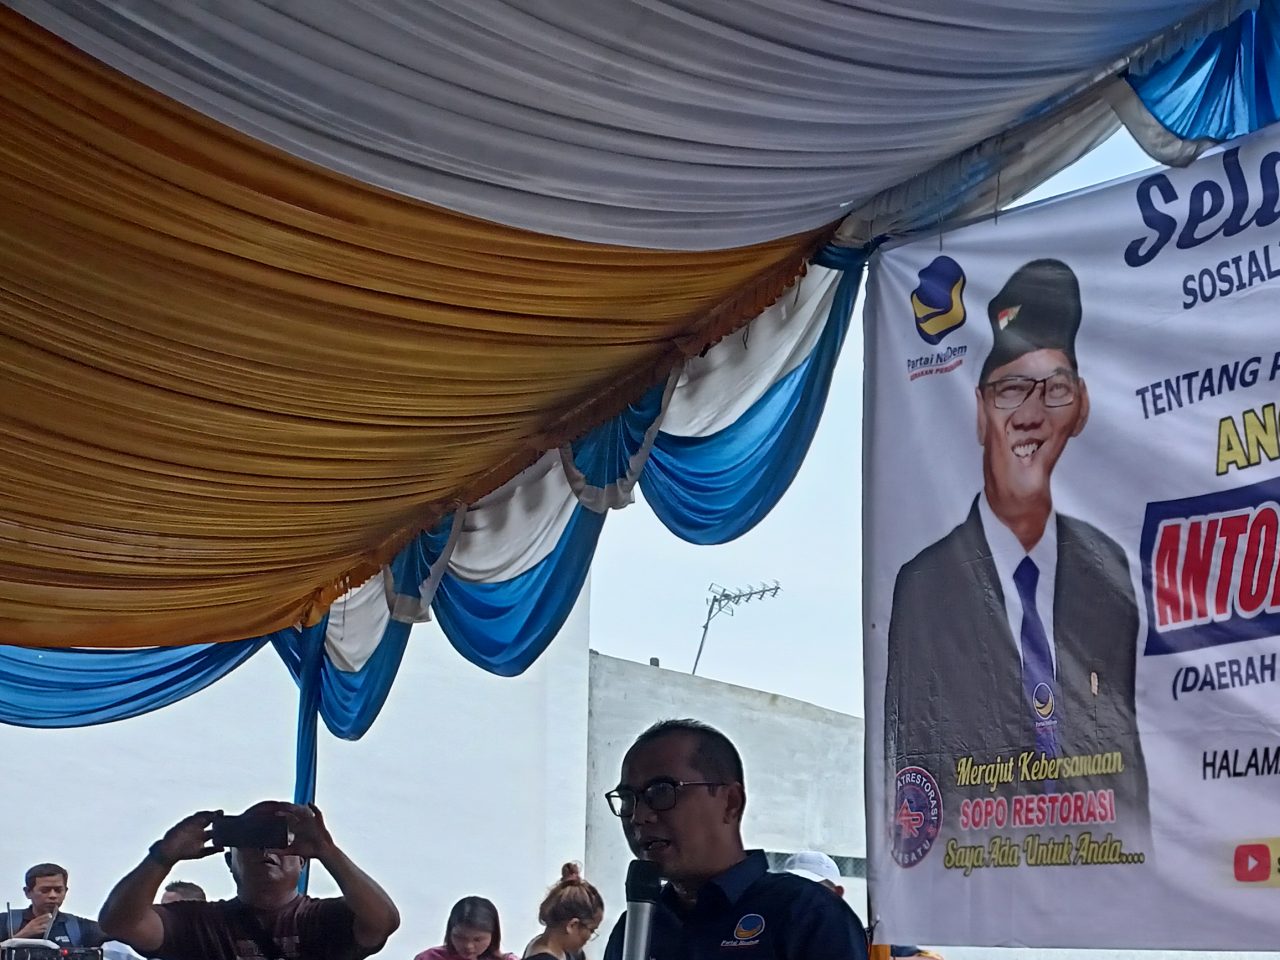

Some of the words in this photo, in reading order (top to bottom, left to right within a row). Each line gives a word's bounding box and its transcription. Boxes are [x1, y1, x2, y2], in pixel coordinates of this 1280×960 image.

[1135, 356, 1261, 420] TENTANG
[1172, 653, 1276, 700] (DAERAH
[956, 754, 1014, 792] Merajut
[1017, 750, 1124, 782] Kebersamaan
[960, 798, 1008, 830] SOPO
[1012, 789, 1116, 827] RESTORASI
[944, 837, 985, 876] Saya
[984, 835, 1020, 868] Ada
[1024, 834, 1072, 866] Untuk
